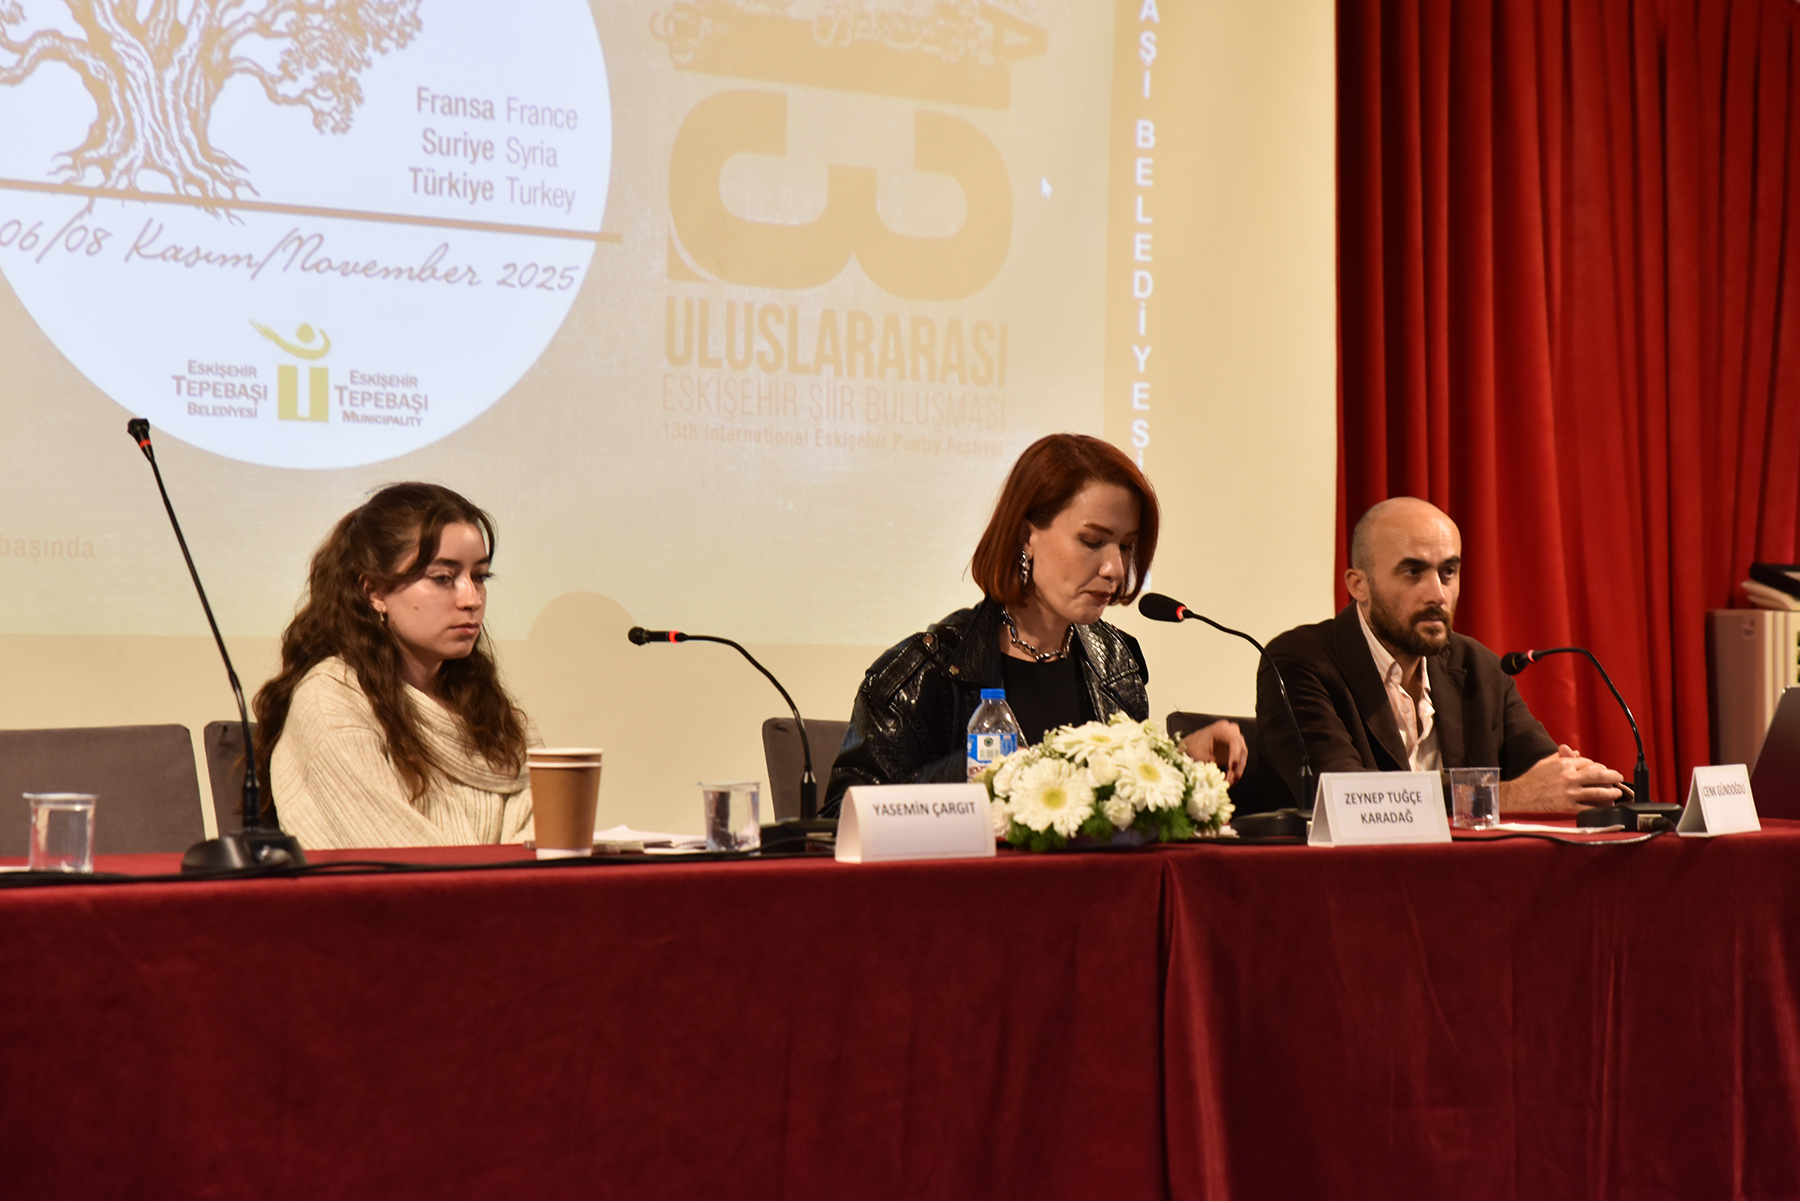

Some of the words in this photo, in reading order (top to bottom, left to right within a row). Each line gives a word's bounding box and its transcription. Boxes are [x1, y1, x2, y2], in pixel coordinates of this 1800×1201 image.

[416, 86, 495, 120] Fransa
[506, 96, 578, 130] France
[422, 127, 494, 165] Suriye
[506, 136, 557, 170] Syria
[408, 167, 494, 205] Türkiye
[506, 176, 576, 215] Turkey
[0, 204, 112, 264] 06/08
[496, 262, 580, 291] 2025
[665, 295, 1009, 389] ULUSLARARASI
[172, 375, 268, 404] TEPEBAŞI
[334, 385, 428, 414] TEPEBAŞI
[662, 371, 798, 422] ESKİŞEHİR
[663, 420, 698, 441] 13th
[704, 423, 808, 447] International
[893, 432, 943, 455] Poetry
[873, 799, 929, 816] YASEMİN
[932, 801, 976, 819] ÇARGIT
[1344, 791, 1385, 805] ZEYNEP
[1387, 788, 1422, 806] TUĞÇE
[1360, 808, 1414, 824] KARADAĞ
